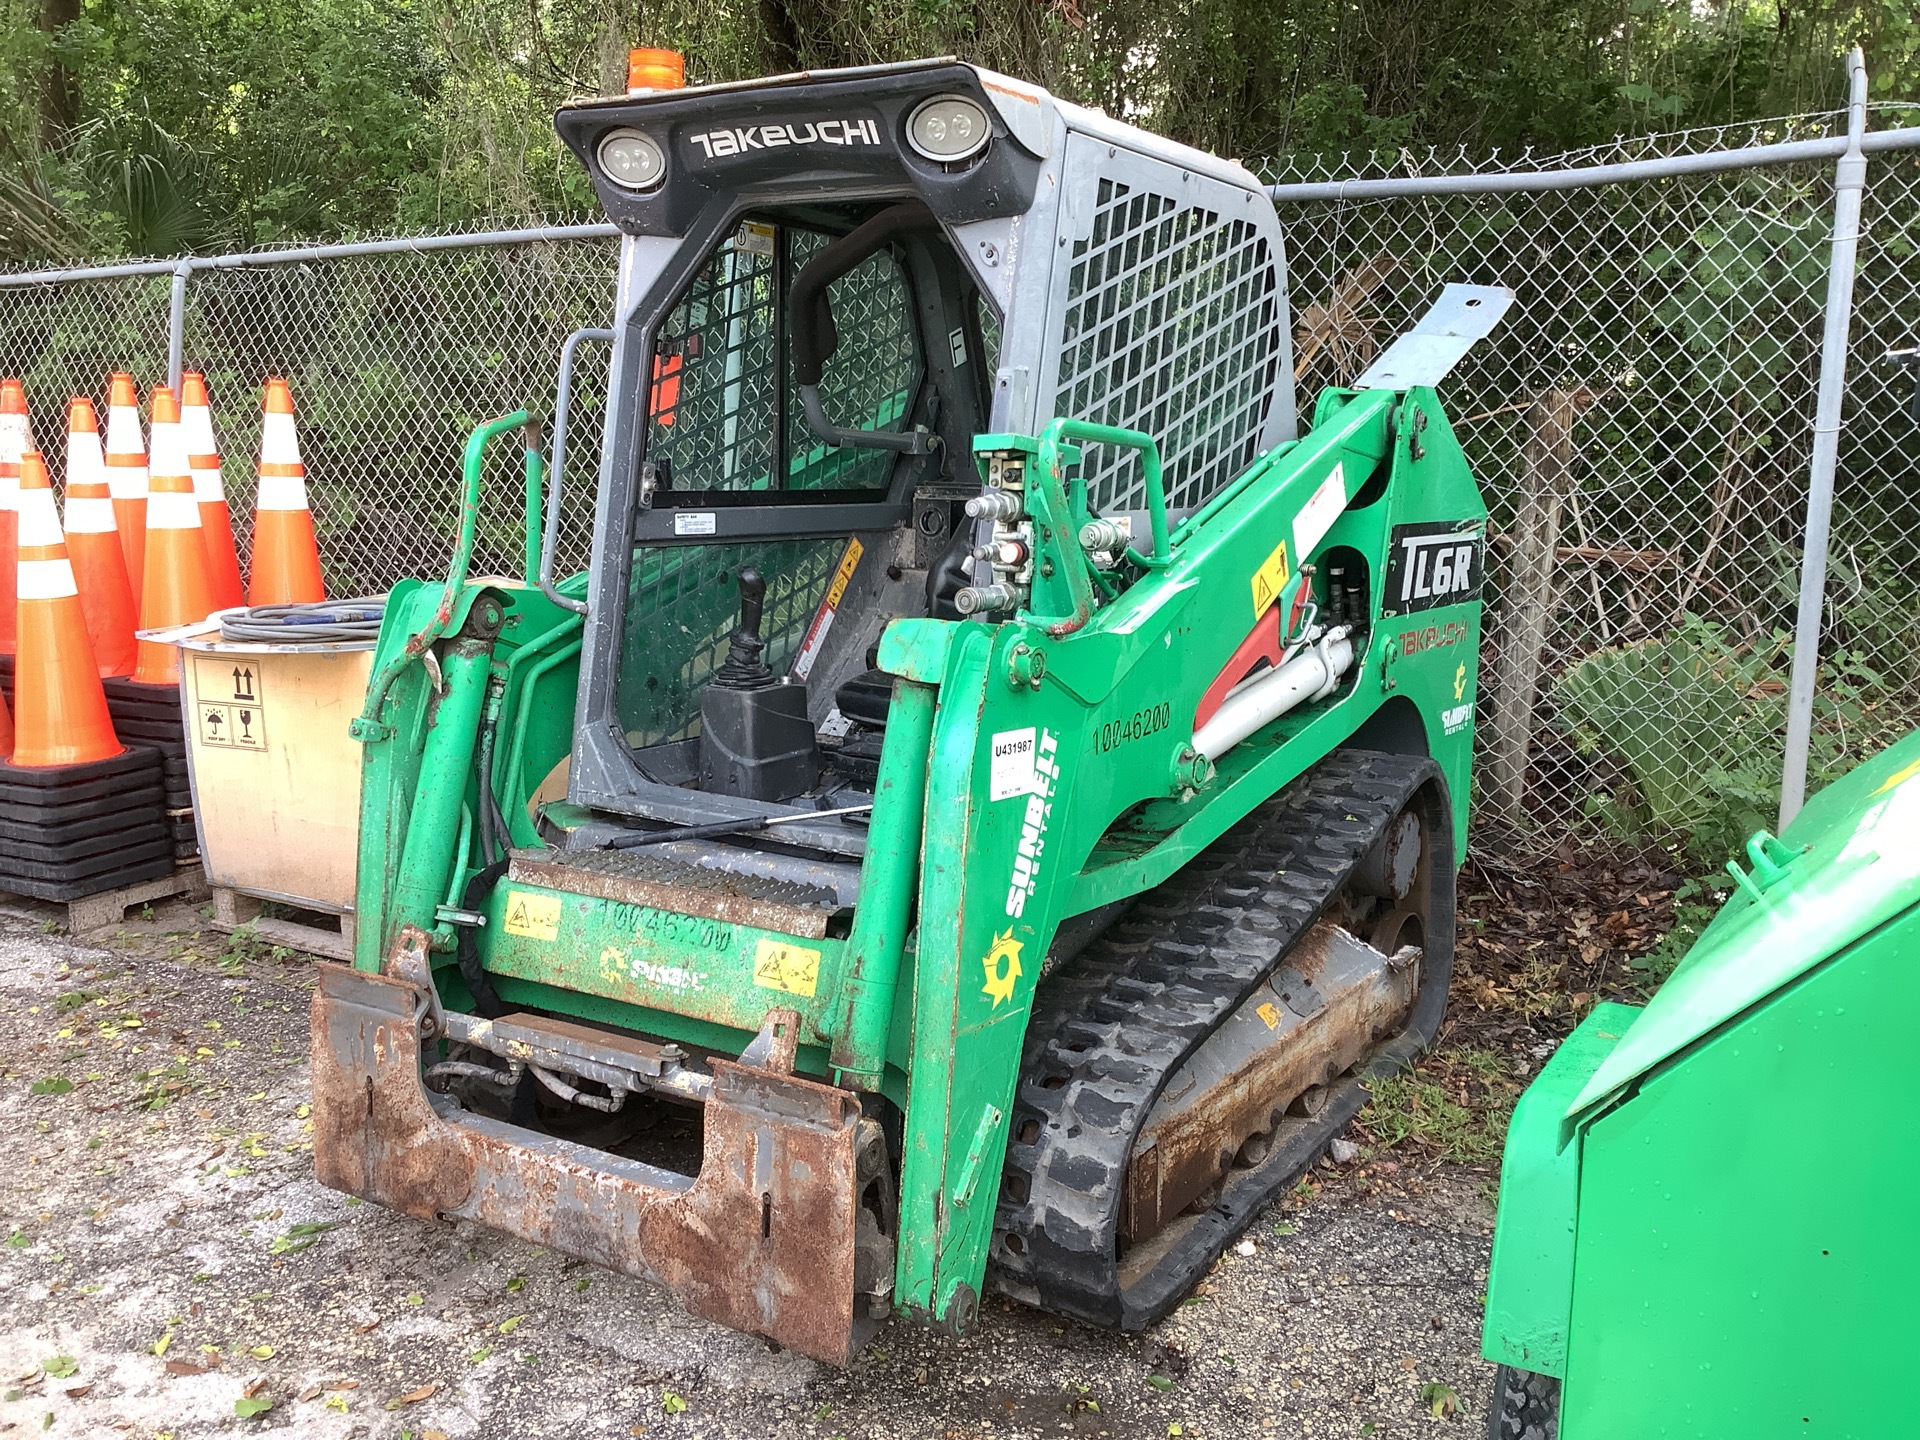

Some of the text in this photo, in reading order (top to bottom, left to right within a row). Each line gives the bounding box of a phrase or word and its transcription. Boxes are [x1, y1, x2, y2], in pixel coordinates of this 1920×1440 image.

[1401, 532, 1478, 602] TL6R
[995, 739, 1032, 758] U431987
[1092, 701, 1170, 756] 10046200
[1005, 727, 1058, 919] SUNBELT
[1026, 764, 1060, 897] RENTALS
